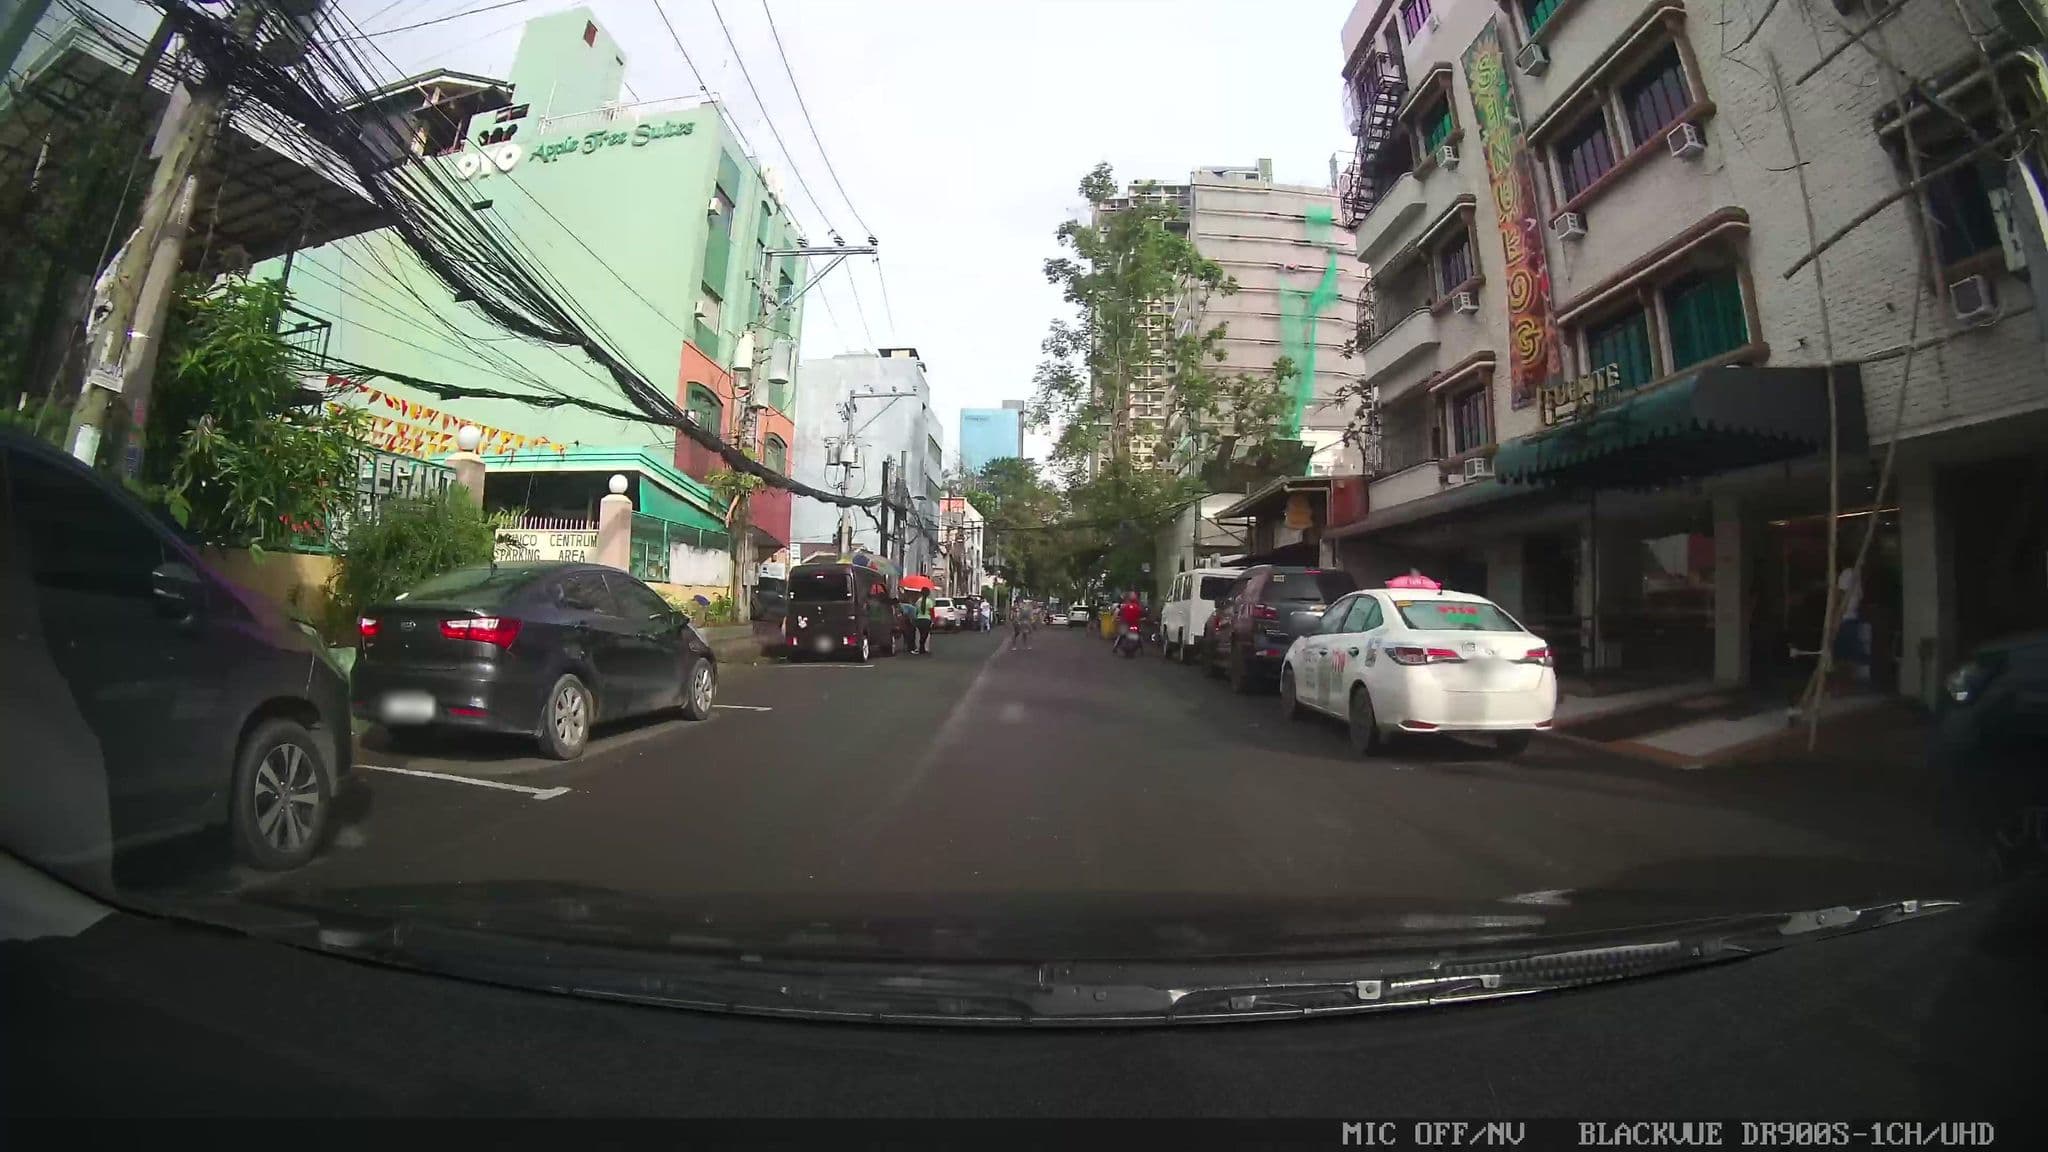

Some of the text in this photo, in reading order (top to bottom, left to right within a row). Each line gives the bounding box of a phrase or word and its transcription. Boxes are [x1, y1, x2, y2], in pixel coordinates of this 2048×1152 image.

[529, 120, 697, 164] Apple Tree Suites
[549, 533, 598, 548] CENTRUM
[500, 548, 586, 563] PARKING AREA
